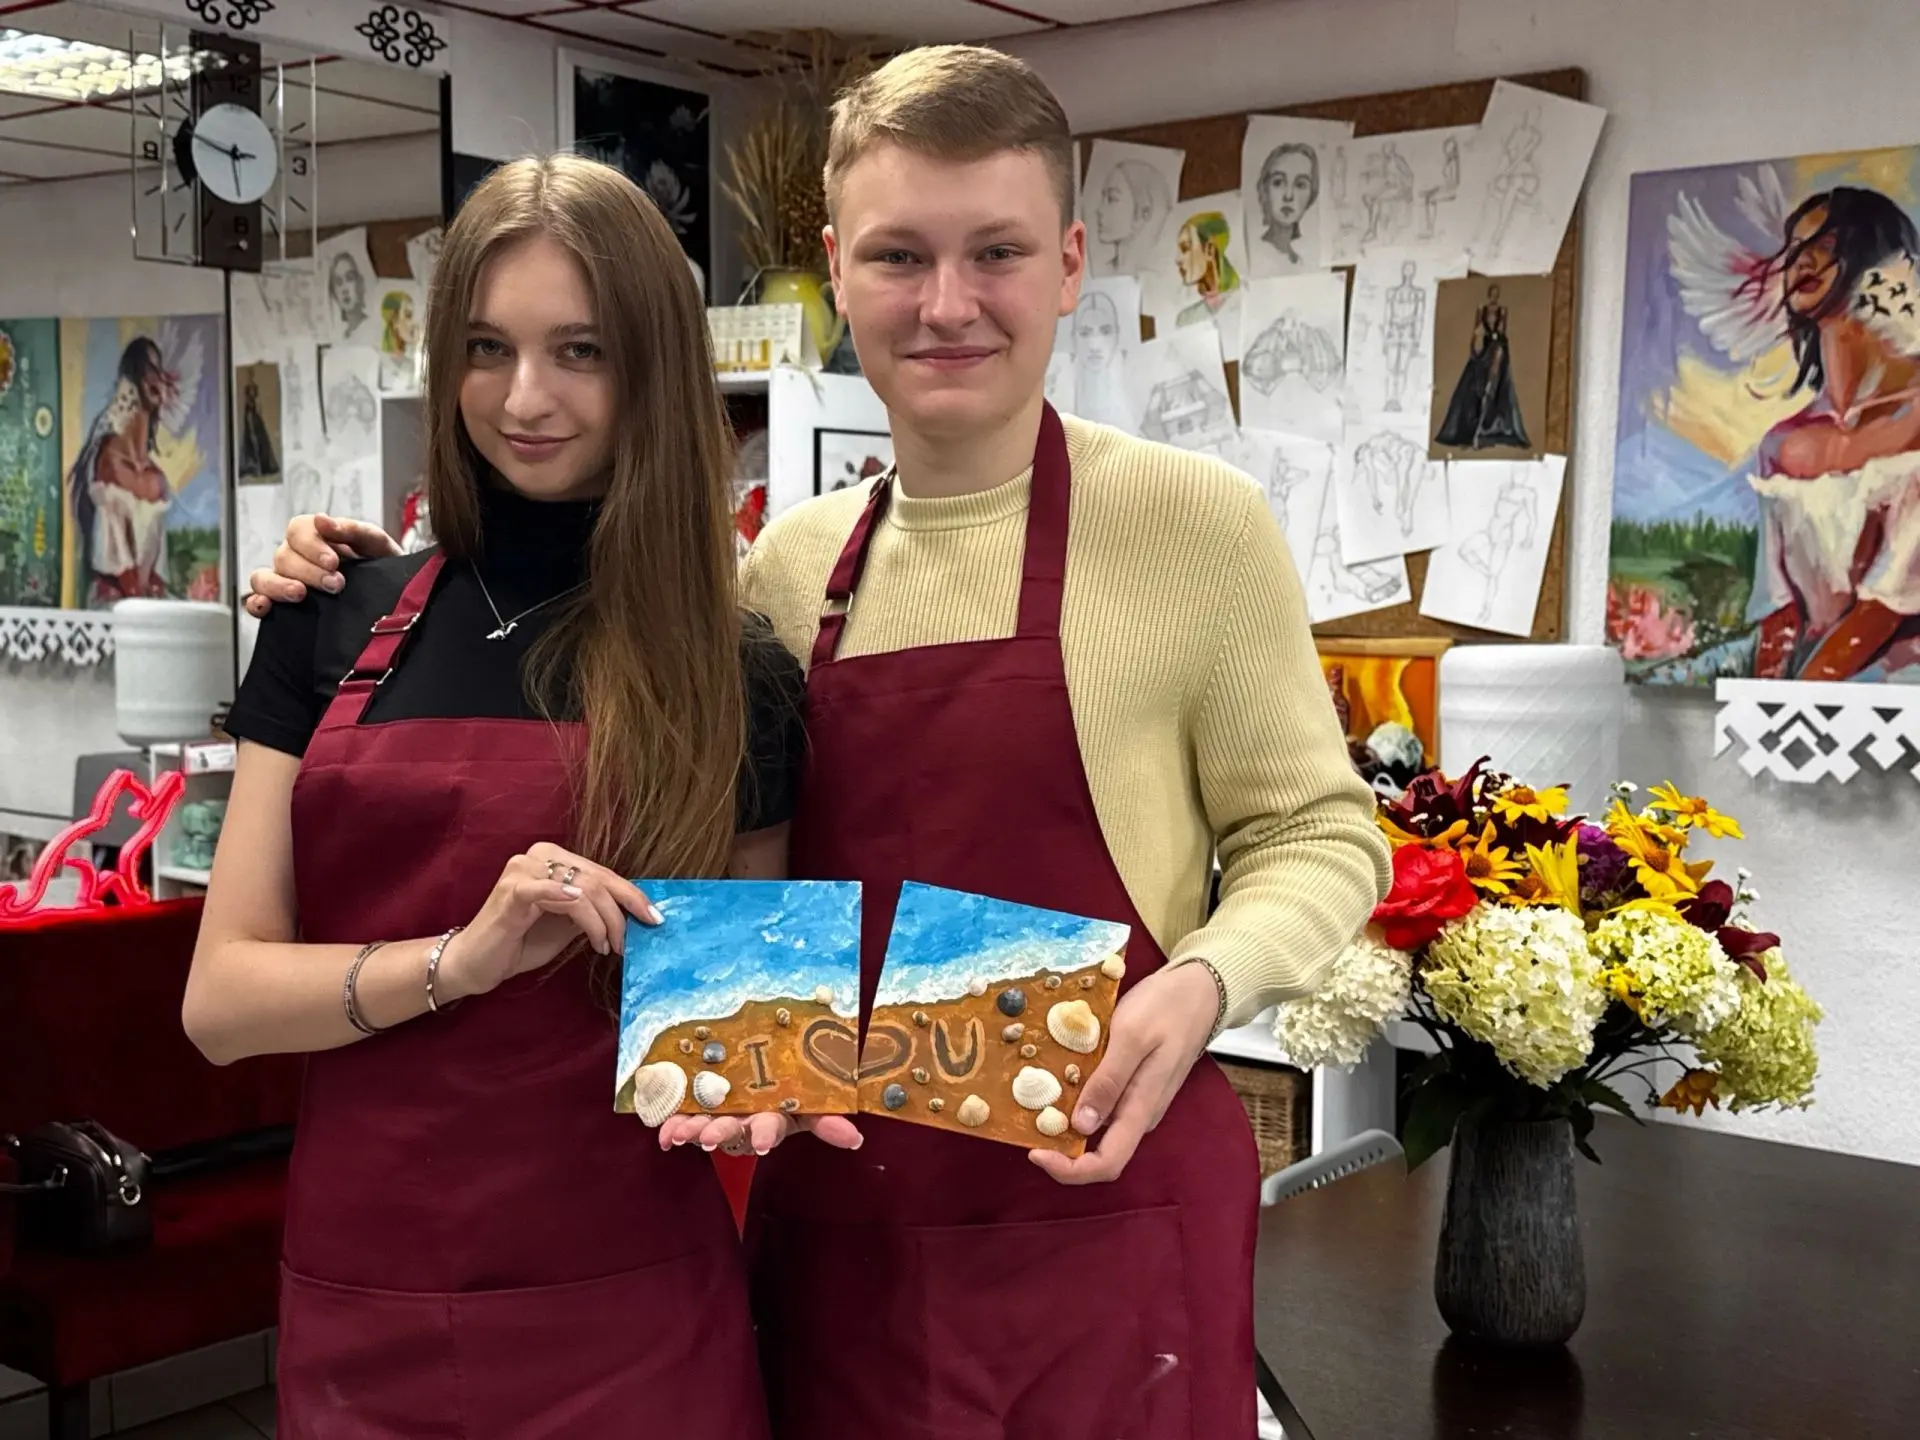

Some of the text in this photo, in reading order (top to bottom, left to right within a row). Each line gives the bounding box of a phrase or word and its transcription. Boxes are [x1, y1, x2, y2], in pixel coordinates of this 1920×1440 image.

[228, 74, 251, 95] 12
[292, 156, 307, 176] 3
[741, 1016, 985, 1091] I U
